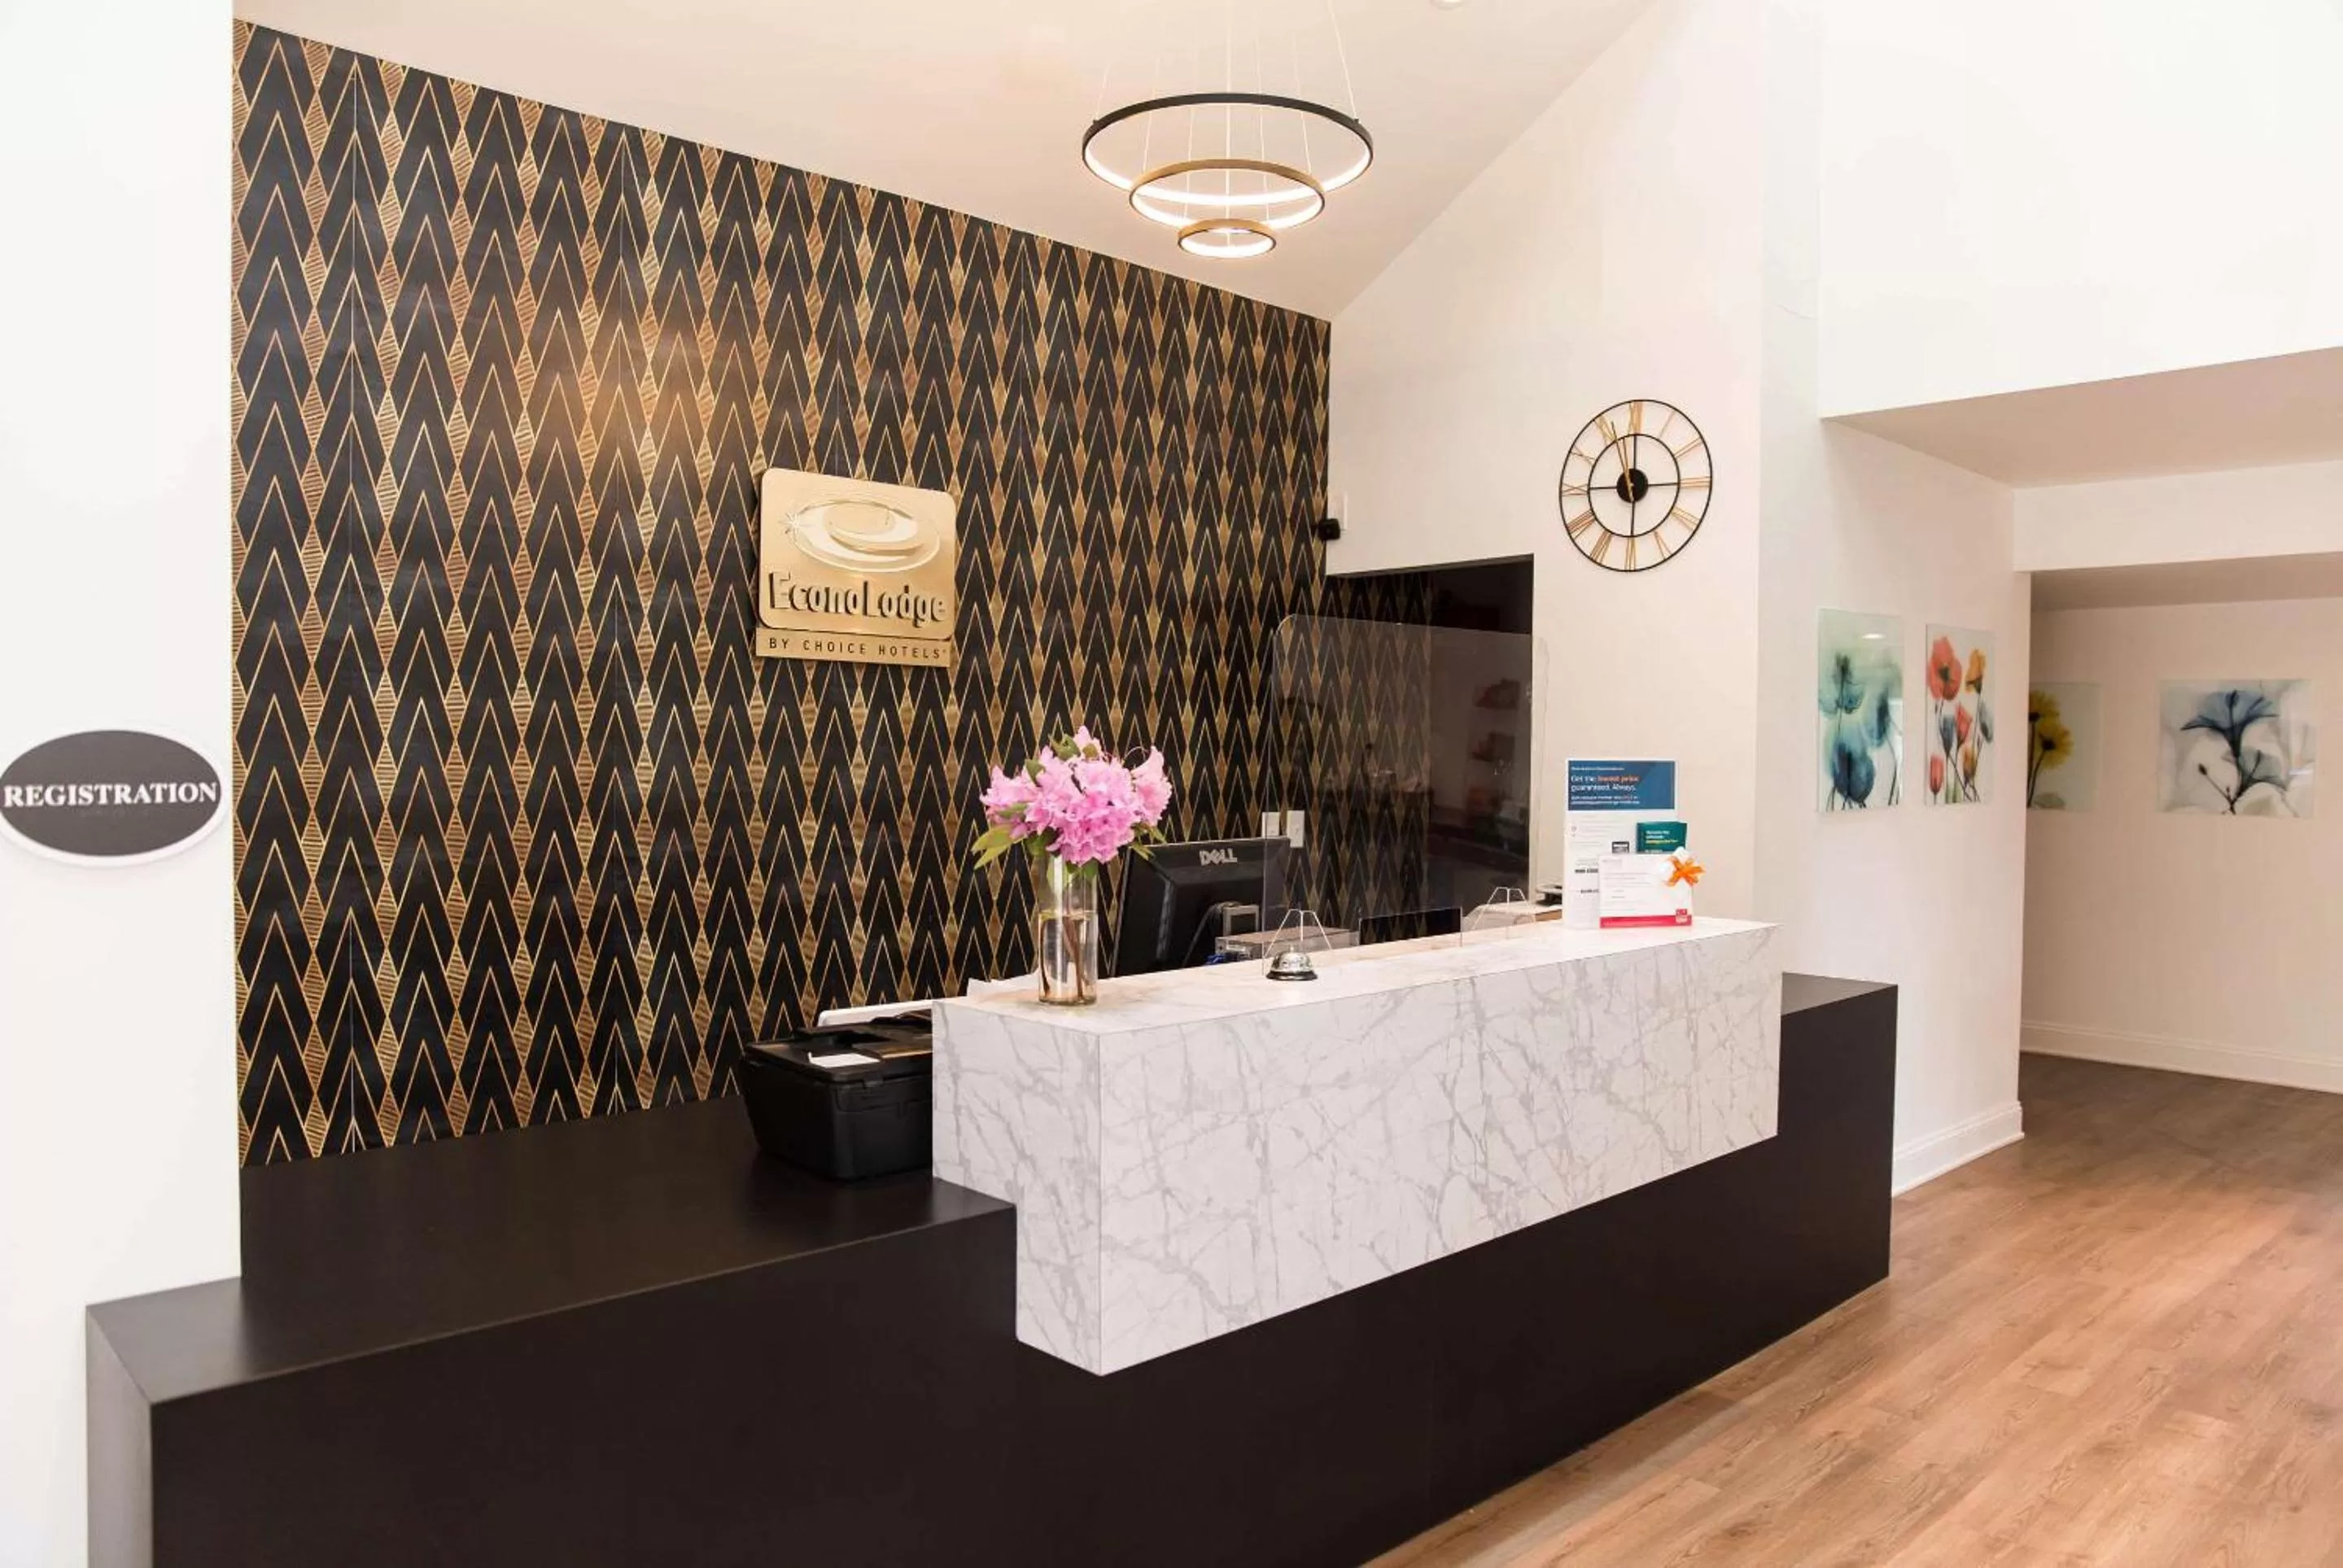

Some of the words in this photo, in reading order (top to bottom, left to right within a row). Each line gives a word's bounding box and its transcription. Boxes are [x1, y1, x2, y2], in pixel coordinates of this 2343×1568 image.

[768, 637, 789, 649] BY
[802, 640, 867, 655] CHOICE
[878, 644, 941, 659] HOTELS
[3, 781, 218, 808] REGISTRATION
[1199, 848, 1238, 867] DELL
